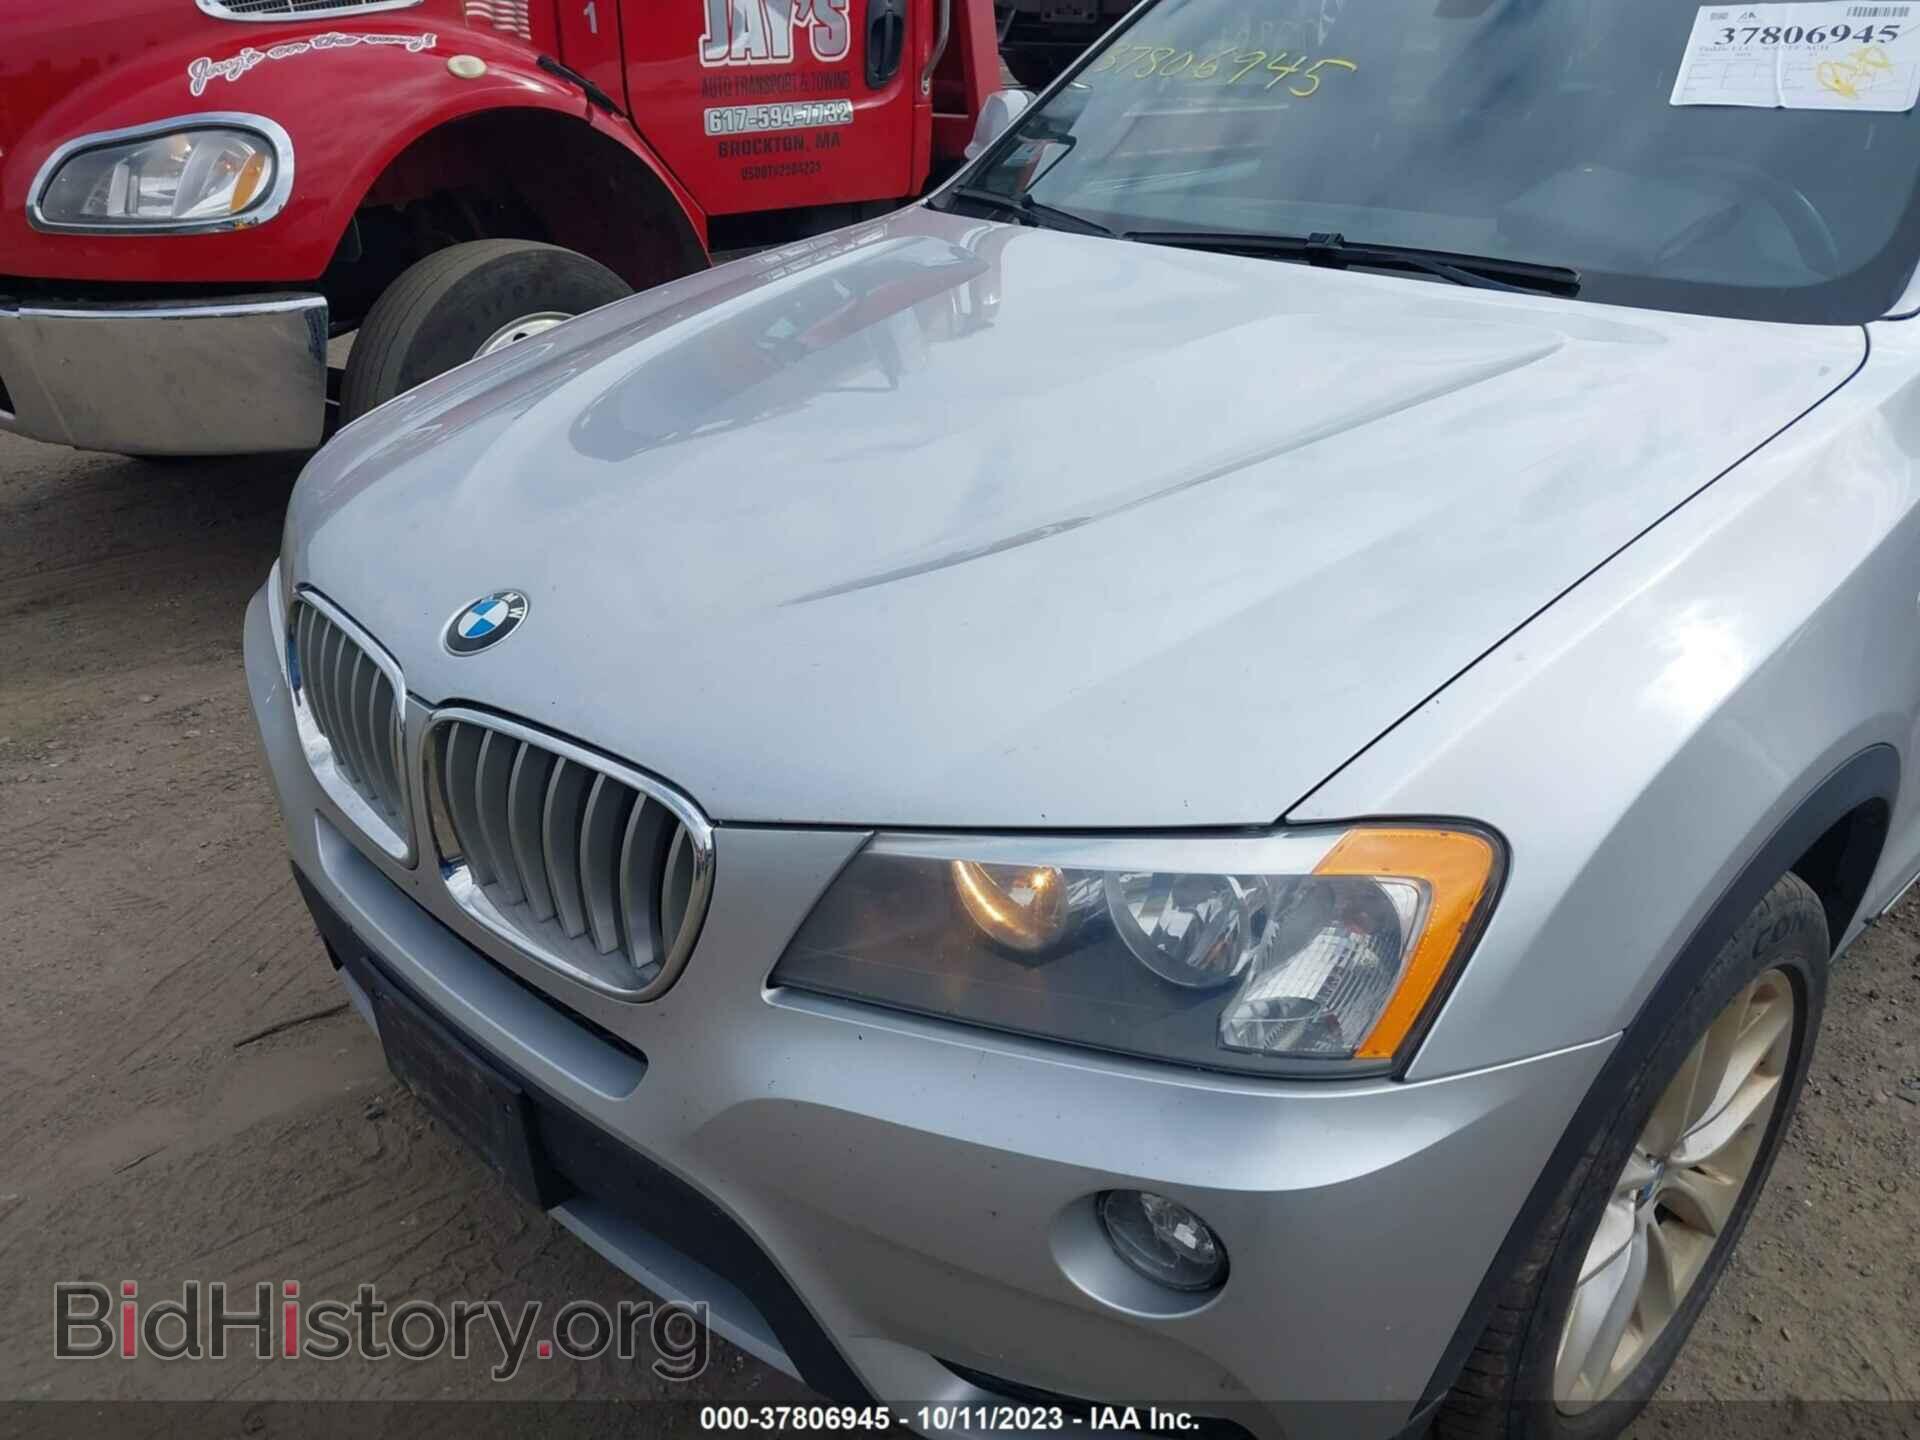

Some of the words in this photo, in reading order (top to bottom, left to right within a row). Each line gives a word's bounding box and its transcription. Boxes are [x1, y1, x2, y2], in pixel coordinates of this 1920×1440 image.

[584, 1, 598, 34] 1
[1714, 25, 1901, 45] 37806945
[702, 75, 732, 97] AUTO
[735, 72, 797, 96] TRANSPORT
[1090, 45, 1358, 97] 37806945
[708, 100, 851, 133] 617-594-7732
[814, 132, 841, 149] MA
